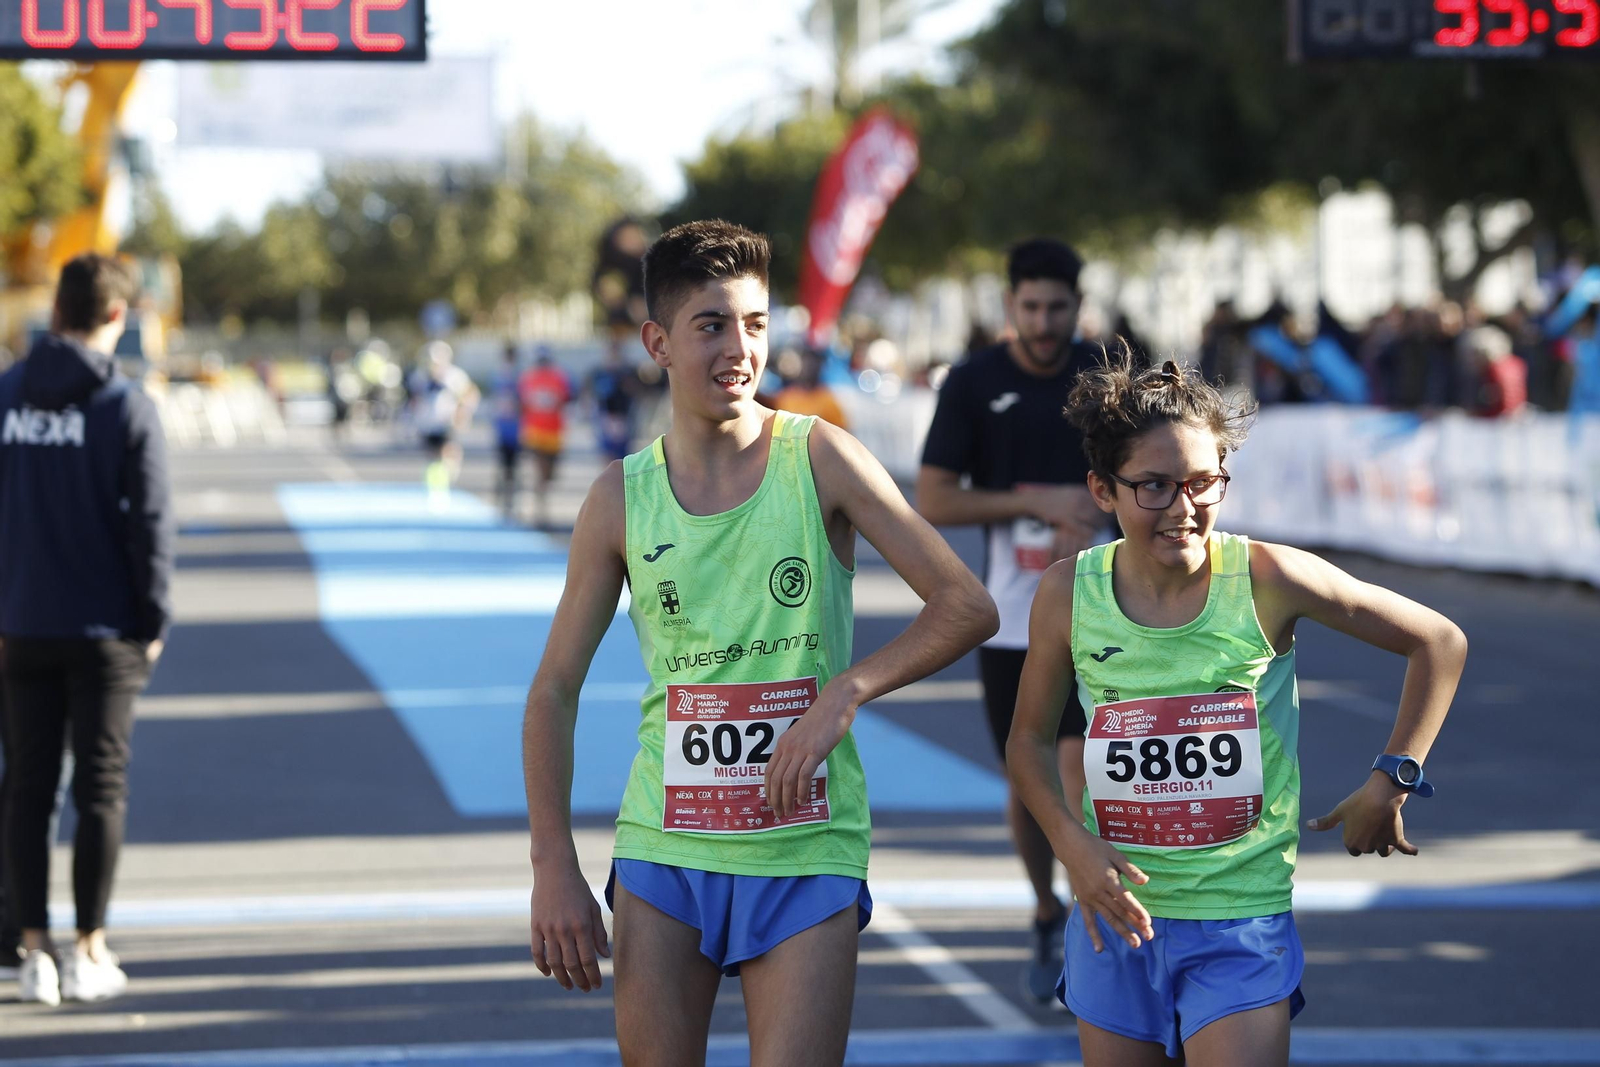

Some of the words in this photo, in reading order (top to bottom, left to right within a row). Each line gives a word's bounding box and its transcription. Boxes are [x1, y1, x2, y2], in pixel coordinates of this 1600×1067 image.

[2, 407, 85, 447] NEXA
[663, 617, 692, 628] ALMERÍA
[749, 633, 819, 657] Running
[761, 687, 809, 701] CARRERA
[697, 699, 729, 707] MARATÓN
[749, 700, 810, 714] SALUDABLE
[1191, 703, 1245, 714] CARRERA
[697, 706, 726, 714] ALMERÍA
[1124, 709, 1144, 717] MEDIO
[1124, 714, 1157, 725] MARATÓN
[1178, 714, 1246, 727] SALUDABLE
[1124, 722, 1154, 732] ALMERÍA
[682, 718, 800, 766] 602
[1106, 733, 1242, 782] 5869
[714, 766, 765, 778] MIGUEL
[1133, 780, 1213, 795] SEERGIO.11
[676, 791, 693, 799] NEXA
[1105, 805, 1124, 813] NEXA
